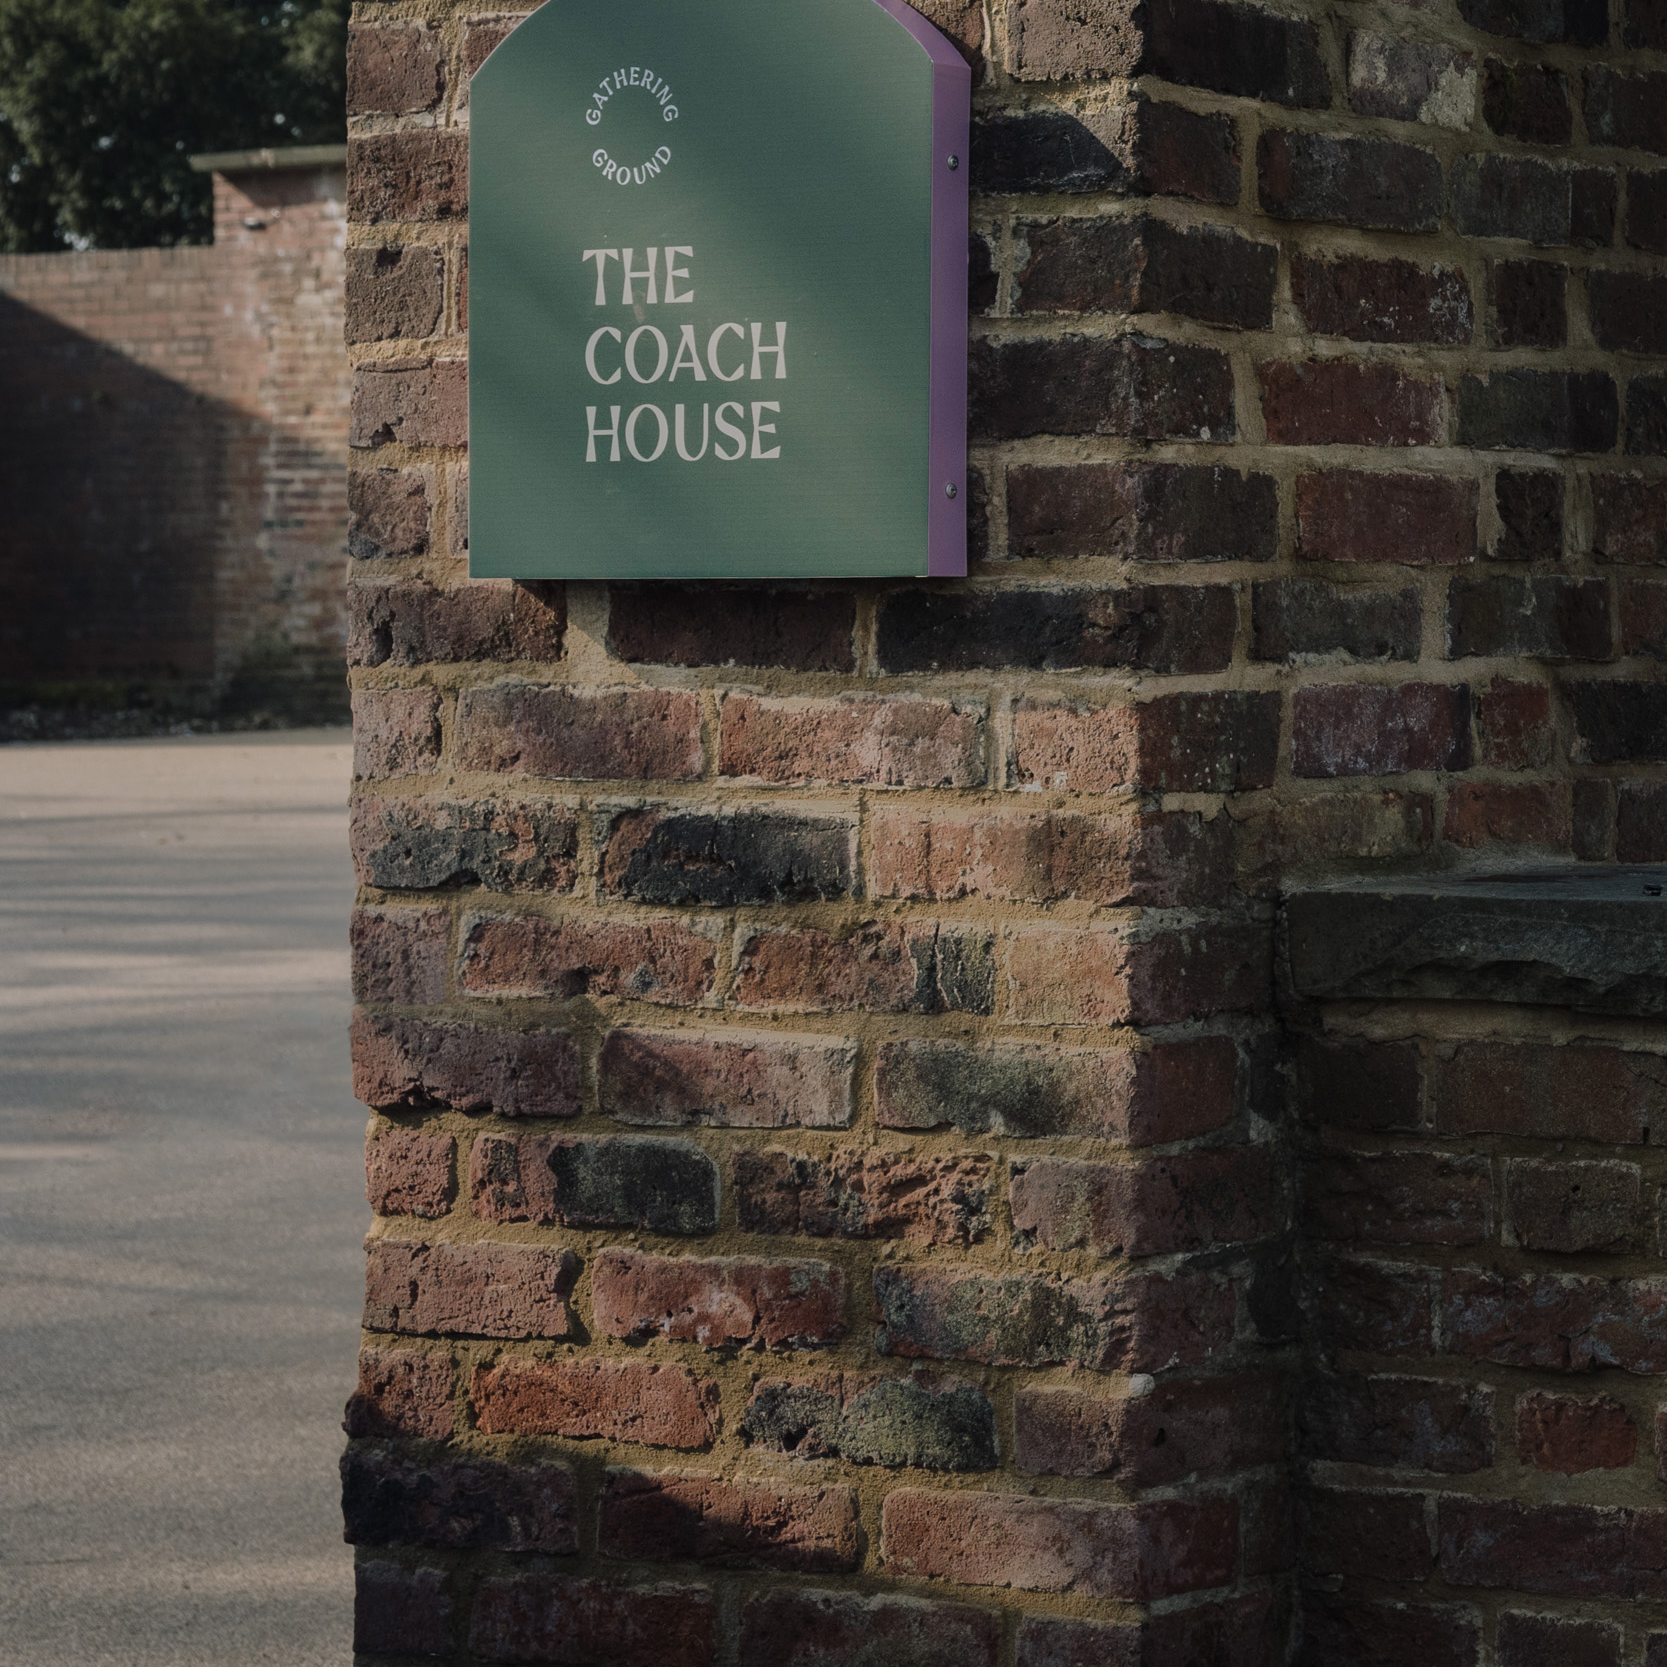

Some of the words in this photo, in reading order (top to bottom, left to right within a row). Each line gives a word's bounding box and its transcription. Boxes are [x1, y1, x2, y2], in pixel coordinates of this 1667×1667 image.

[585, 67, 679, 125] GATHERING
[592, 146, 672, 185] GROUND
[582, 246, 694, 305] THE
[585, 322, 787, 384] COACH
[585, 401, 781, 462] HOUSE
